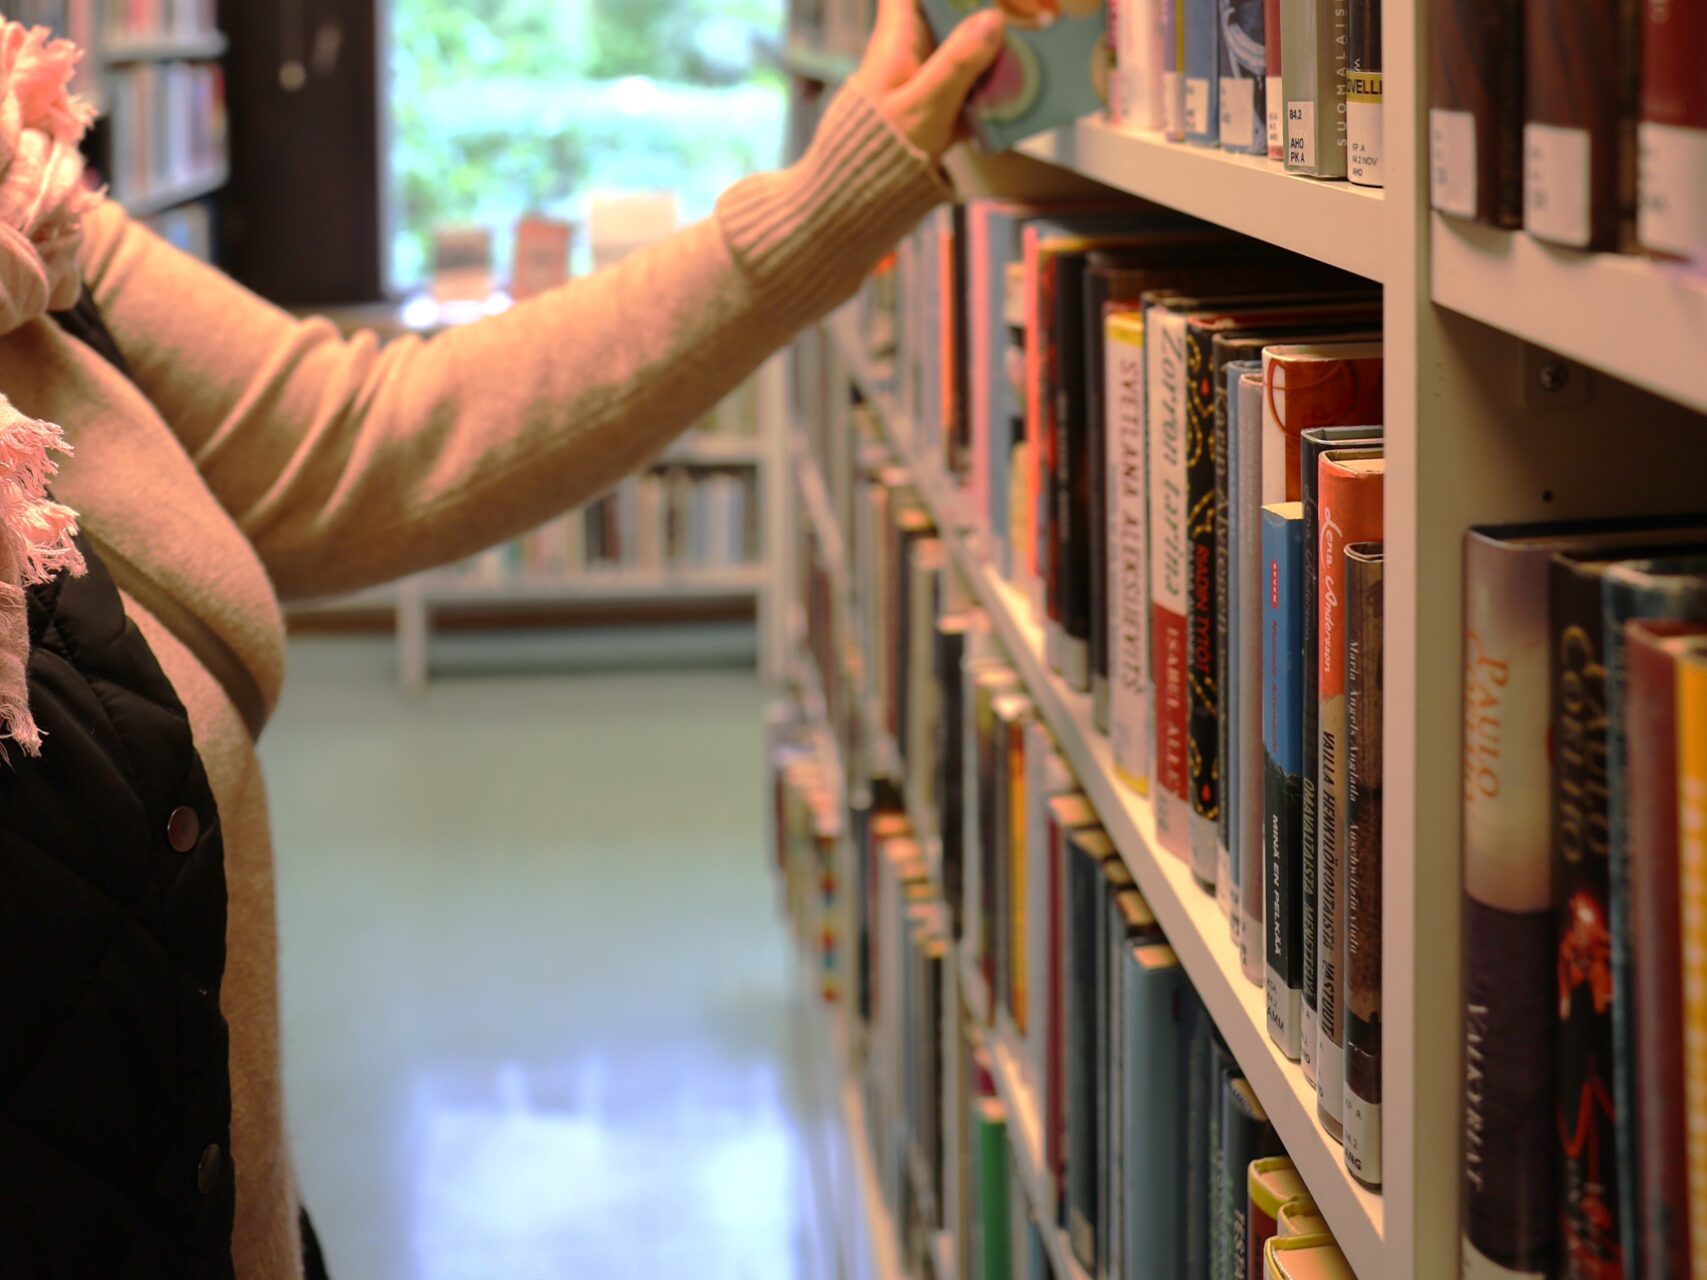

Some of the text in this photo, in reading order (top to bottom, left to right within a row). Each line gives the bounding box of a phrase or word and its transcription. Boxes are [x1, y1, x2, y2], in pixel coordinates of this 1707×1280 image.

[1289, 108, 1303, 120] 84.2
[1290, 137, 1304, 149] AHO
[1290, 151, 1299, 163] PK
[1119, 358, 1141, 497] SVETLANA
[1161, 328, 1185, 597] Zorron tarina
[1320, 507, 1343, 673] Lena Andersson
[1349, 639, 1360, 681] Maria
[1322, 730, 1335, 785] VAILLA
[1347, 740, 1360, 803] Anglada
[1476, 652, 1510, 800] PAULO
[1272, 813, 1283, 957] MINÄ EN PELKÄÄ
[1303, 776, 1315, 896] OMAVALTAISTA
[1322, 789, 1338, 948] HENKILÖKOHTAISTA
